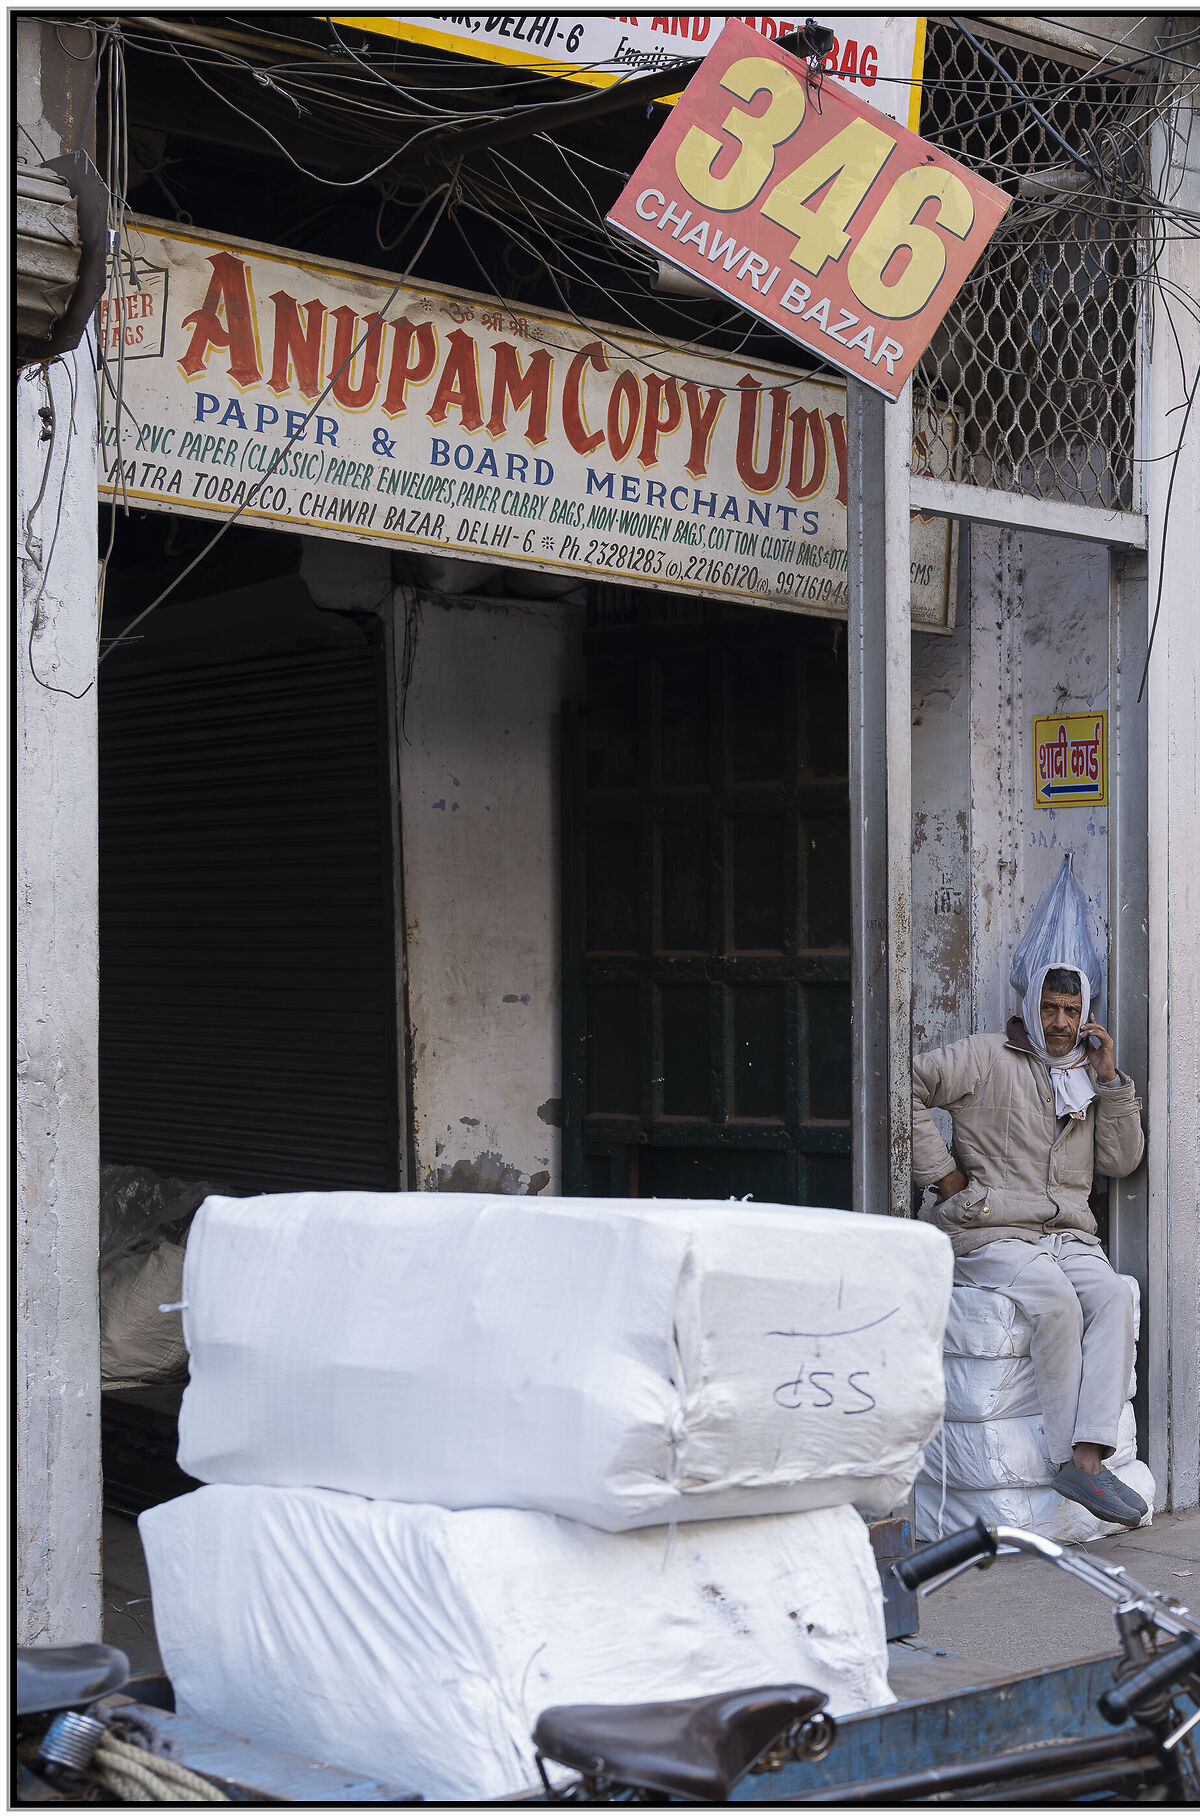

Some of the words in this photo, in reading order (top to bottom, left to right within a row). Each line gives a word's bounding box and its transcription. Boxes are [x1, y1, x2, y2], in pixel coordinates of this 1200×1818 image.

[674, 56, 975, 321] 346
[101, 293, 154, 325] APER
[635, 188, 781, 295] CHAWRI
[779, 277, 904, 376] BAZAR
[177, 251, 554, 446] ANUPAM
[562, 340, 727, 477] COPY
[106, 458, 183, 494] KATRA
[299, 491, 378, 528] CHAWRI
[383, 505, 450, 544] BAZAR,
[135, 423, 176, 454] PVC
[177, 431, 239, 467] PAPER
[240, 437, 324, 484] (CLASSIC)
[324, 457, 374, 492] PAPER
[456, 481, 501, 515] PAPER
[501, 490, 549, 521] CARRY
[708, 526, 760, 558] COTTON
[760, 535, 797, 563] CLOTH
[195, 391, 340, 448] PAPER
[371, 427, 397, 458] &
[430, 437, 554, 486] BOARD
[585, 467, 819, 535] MERCHANTS
[1038, 726, 1069, 782] शादी
[1070, 722, 1101, 783] कार्ड
